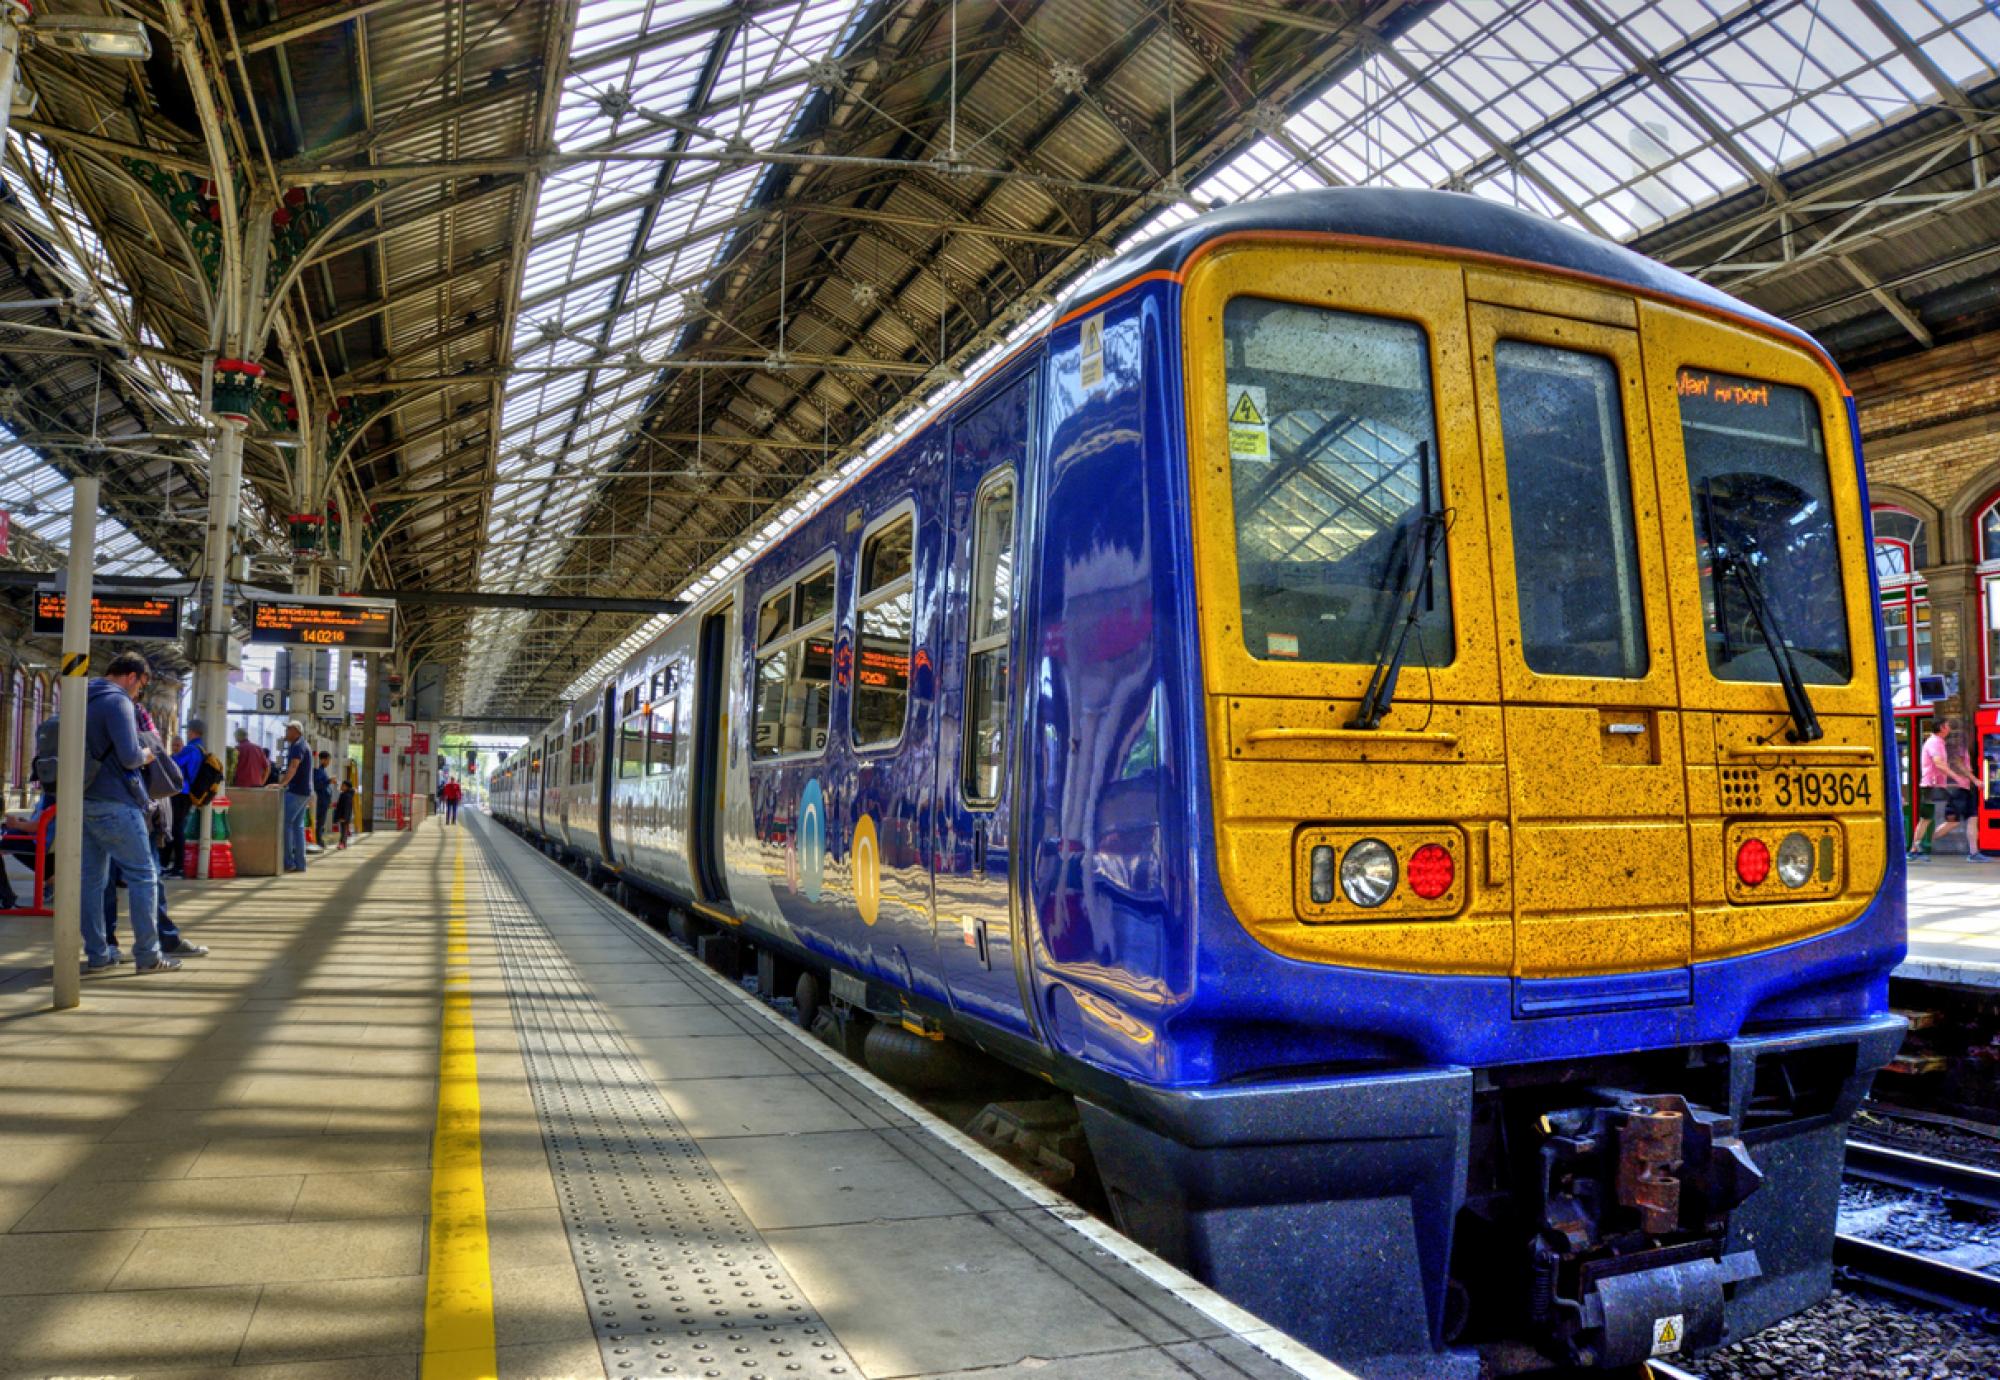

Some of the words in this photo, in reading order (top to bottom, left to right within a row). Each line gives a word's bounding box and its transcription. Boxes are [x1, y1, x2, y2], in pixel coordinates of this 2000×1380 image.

[262, 693, 275, 709] 6
[322, 695, 335, 711] 5
[1774, 772, 1872, 807] 319364
